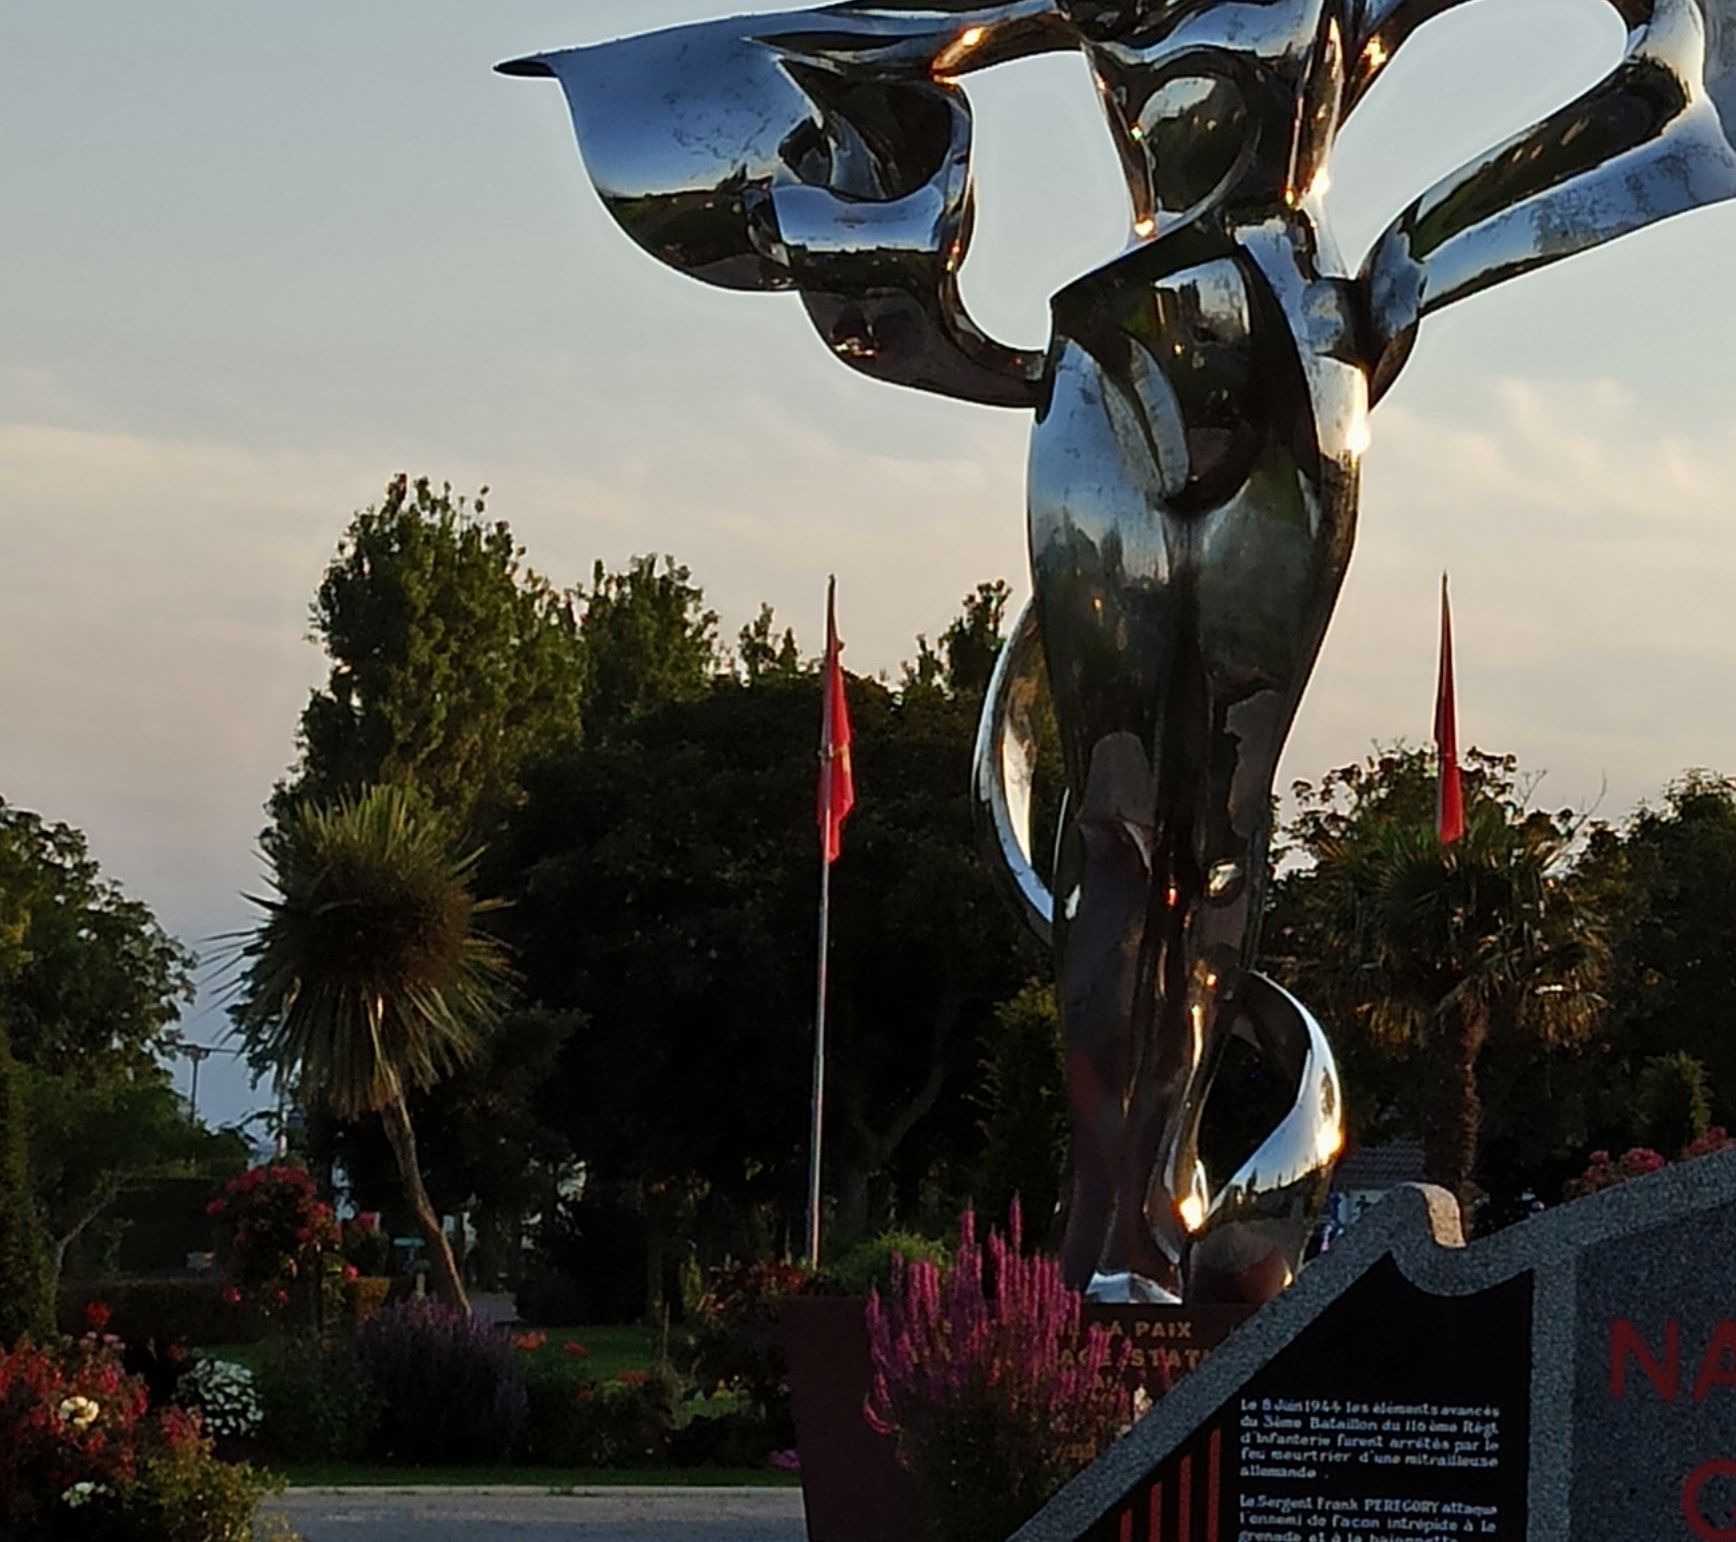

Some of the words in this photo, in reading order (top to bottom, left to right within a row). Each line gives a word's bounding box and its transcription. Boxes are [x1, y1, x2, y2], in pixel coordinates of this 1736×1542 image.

[1241, 1398, 1258, 1411] Le
[1305, 1399, 1342, 1413] 1944
[1346, 1401, 1369, 1414] les
[1240, 1415, 1258, 1428] du
[1310, 1416, 1378, 1431] Bataillon
[1381, 1419, 1401, 1432] du
[1337, 1433, 1383, 1448] furent
[1454, 1441, 1479, 1454] par
[1241, 1448, 1266, 1460] feu
[1271, 1450, 1351, 1463] meurtrier
[1256, 1494, 1313, 1514] Sergent
[1364, 1498, 1440, 1514] PEREGORY
[1306, 1514, 1327, 1527] de
